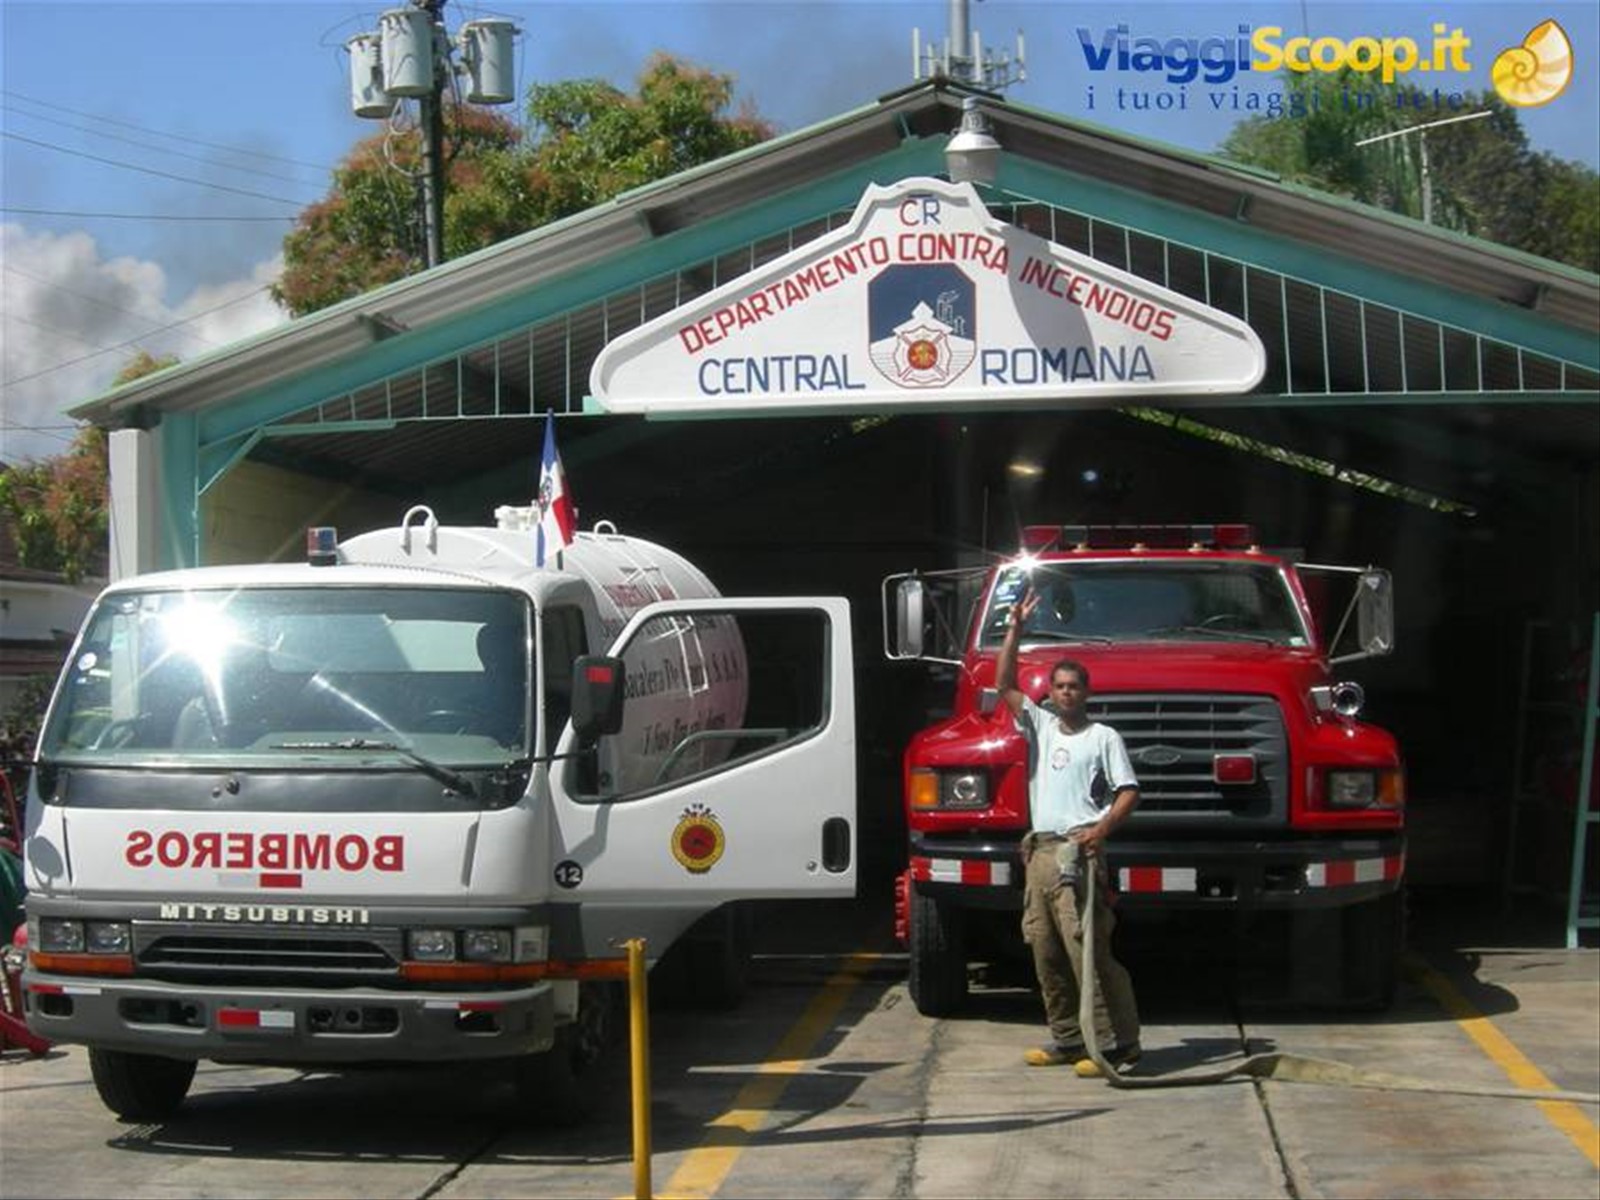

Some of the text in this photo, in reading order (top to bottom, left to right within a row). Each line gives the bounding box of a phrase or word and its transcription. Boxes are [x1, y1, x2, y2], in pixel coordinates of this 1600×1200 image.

[900, 198, 941, 227] CR
[679, 232, 1177, 355] DEPARTAMENTO CONTRA INCENDIOS
[698, 345, 1155, 395] CENTRAL ROMANA
[556, 866, 581, 883] 12
[160, 903, 369, 924] MITSUBISHI
